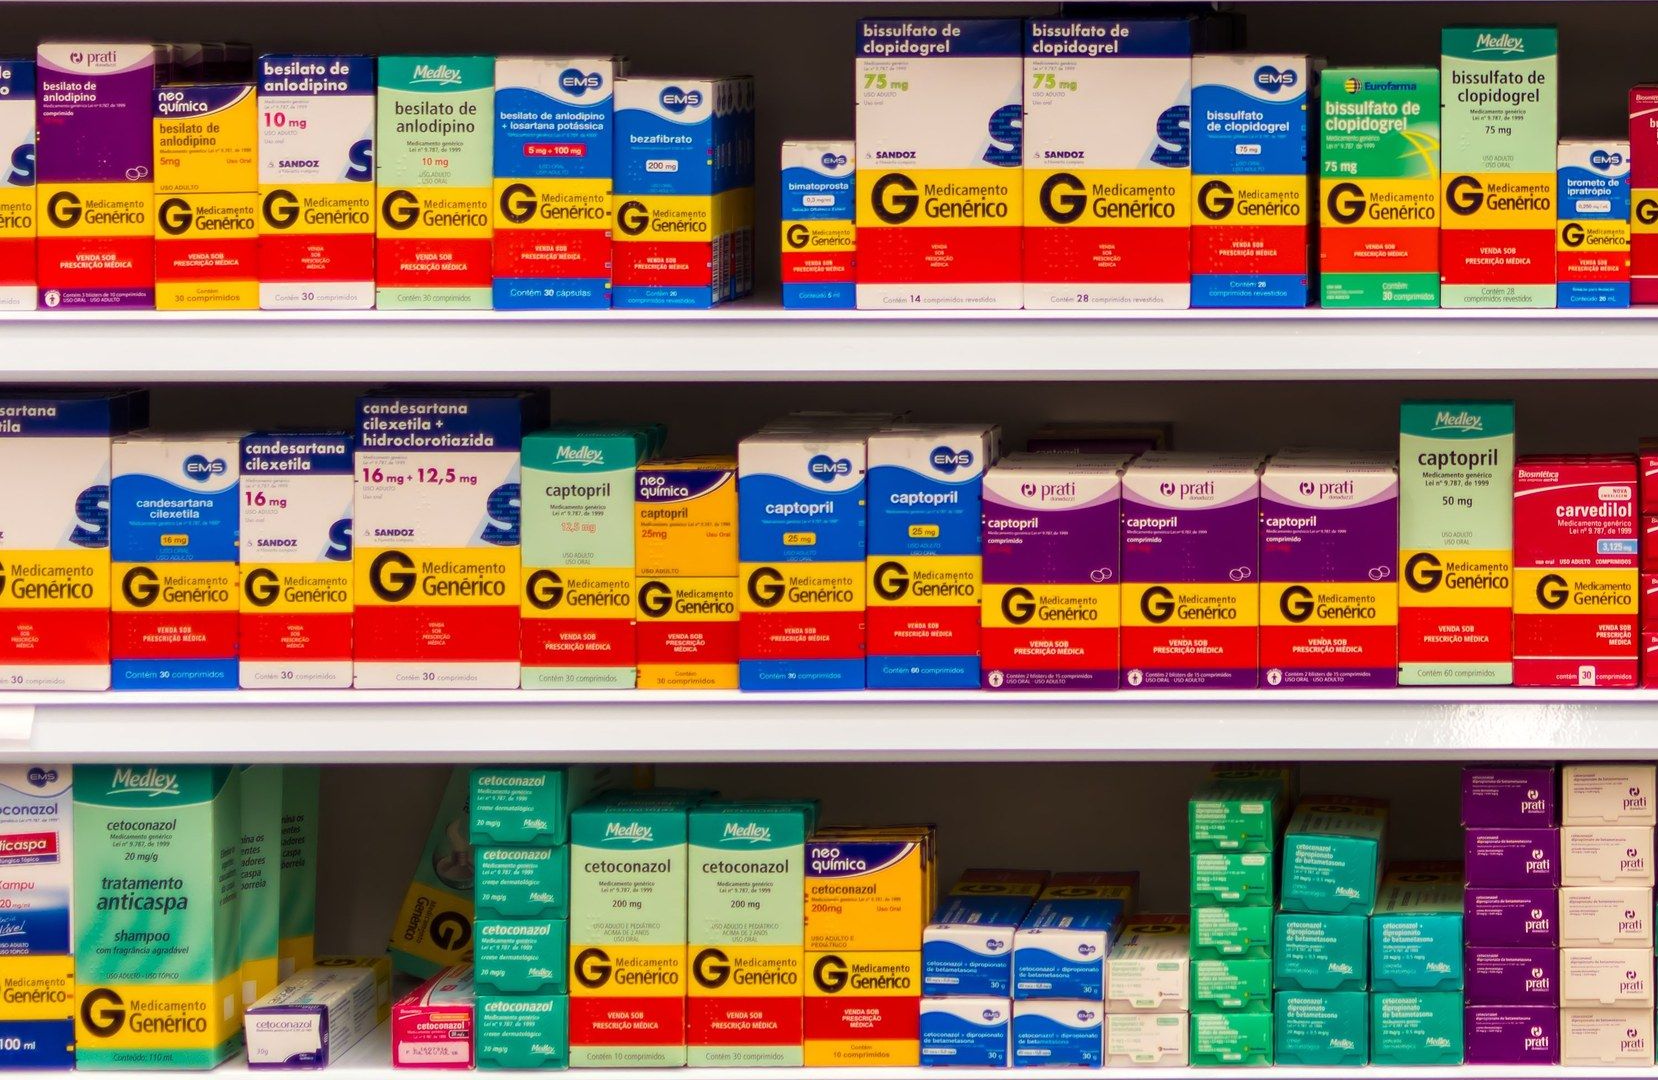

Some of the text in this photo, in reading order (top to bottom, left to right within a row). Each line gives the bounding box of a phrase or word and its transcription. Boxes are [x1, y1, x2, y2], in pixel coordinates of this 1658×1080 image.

[864, 23, 960, 37] bissulfato de
[863, 39, 949, 56] clopidogrel
[158, 92, 184, 103] neo
[158, 100, 207, 115] química
[265, 112, 307, 130] 10 mg
[630, 134, 692, 144] bezafibrato
[788, 182, 849, 191] bimatoprosta
[1567, 178, 1619, 188] brometo de
[1567, 186, 1611, 197] ipratrópio
[363, 401, 468, 414] candesartana
[363, 417, 431, 430] cilexetila
[363, 433, 494, 446] hidroclorotiazida
[765, 501, 834, 516] captopril
[1556, 502, 1632, 517] carvedilol
[1602, 542, 1621, 552] 3,125
[1521, 800, 1545, 813] prati
[584, 859, 671, 873] cetoconazol
[102, 877, 183, 890] tratamento
[97, 892, 188, 915] anticaspa
[612, 900, 642, 909] 200 mg
[1287, 921, 1321, 930] cetoconazol
[115, 929, 170, 944] shampoo
[256, 1020, 312, 1032] cetoconazol
